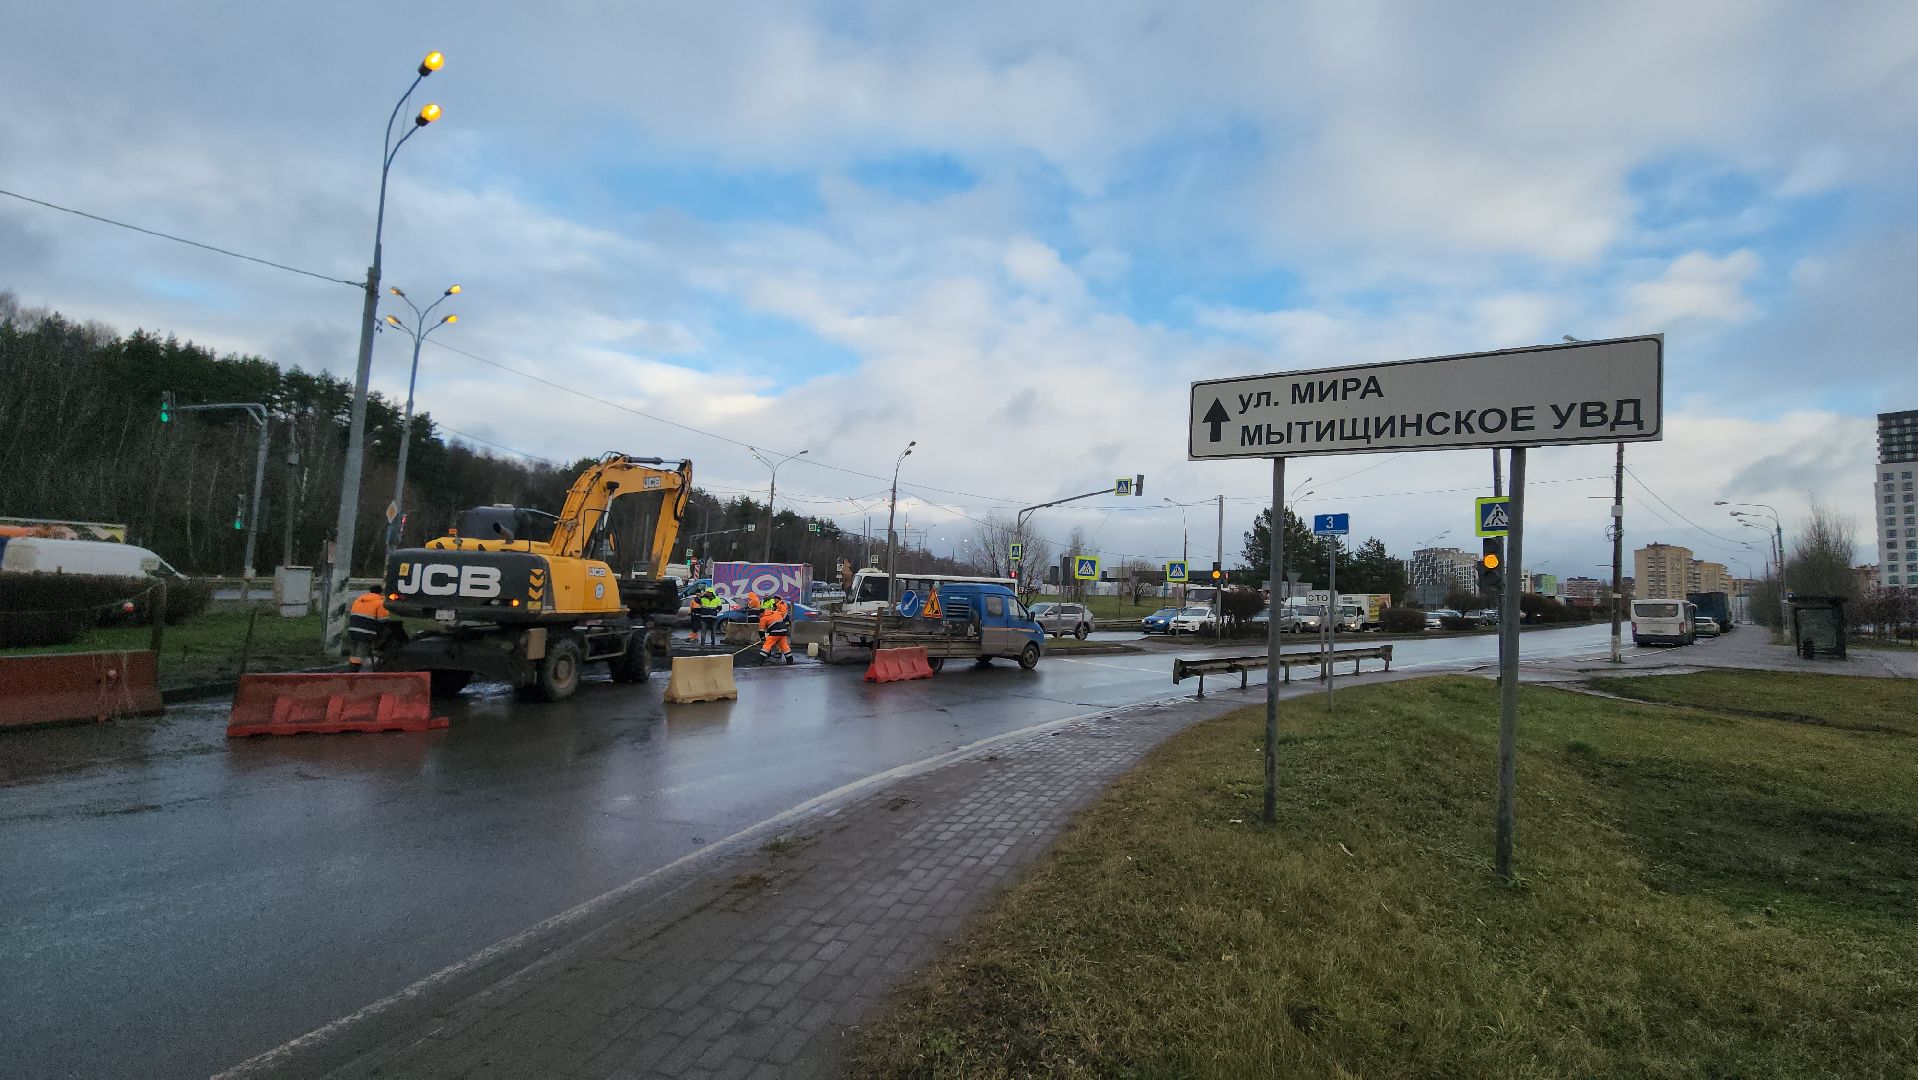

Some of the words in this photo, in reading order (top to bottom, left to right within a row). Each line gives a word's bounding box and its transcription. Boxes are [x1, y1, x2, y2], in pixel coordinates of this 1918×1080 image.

[1238, 391, 1280, 415] ул.
[1291, 375, 1385, 405] МИРА
[1240, 405, 1535, 447] МЫТИЩИНСКОЕ
[1549, 398, 1645, 432] УВД
[644, 477, 661, 489] JCB
[1326, 516, 1334, 529] 3
[397, 562, 502, 598] JCB
[589, 567, 606, 577] JCB
[713, 570, 802, 599] OZON
[1308, 594, 1330, 602] СТО
